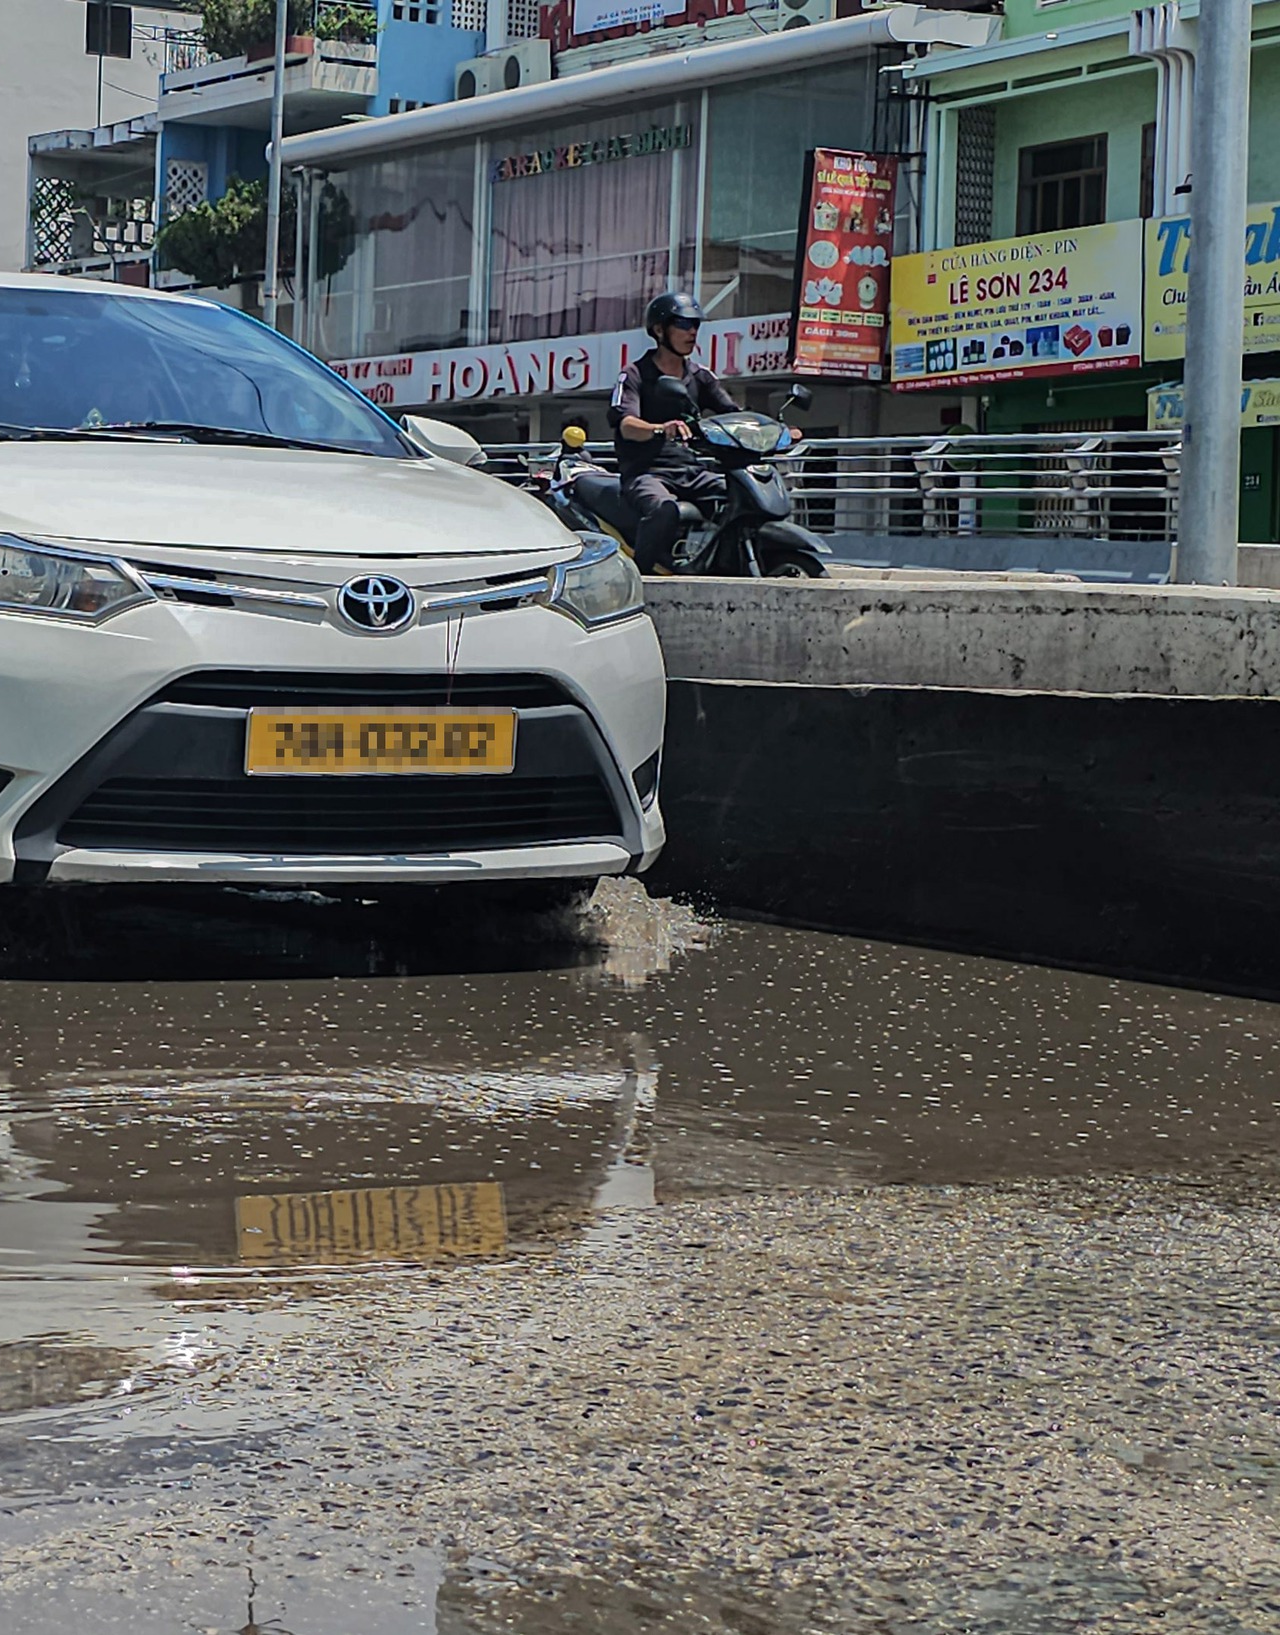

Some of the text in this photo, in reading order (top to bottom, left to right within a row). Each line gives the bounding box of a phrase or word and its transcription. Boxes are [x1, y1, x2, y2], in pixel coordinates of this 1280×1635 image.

[489, 144, 582, 182] KARAOKE
[941, 252, 967, 271] CỬA
[971, 249, 1007, 268] HÀNG
[1054, 238, 1078, 254] PIN
[949, 265, 1068, 305] LÊ SƠN 234
[1162, 271, 1280, 306] Chu ần Á
[749, 319, 790, 340] 0903
[428, 346, 590, 400] HOÀNG
